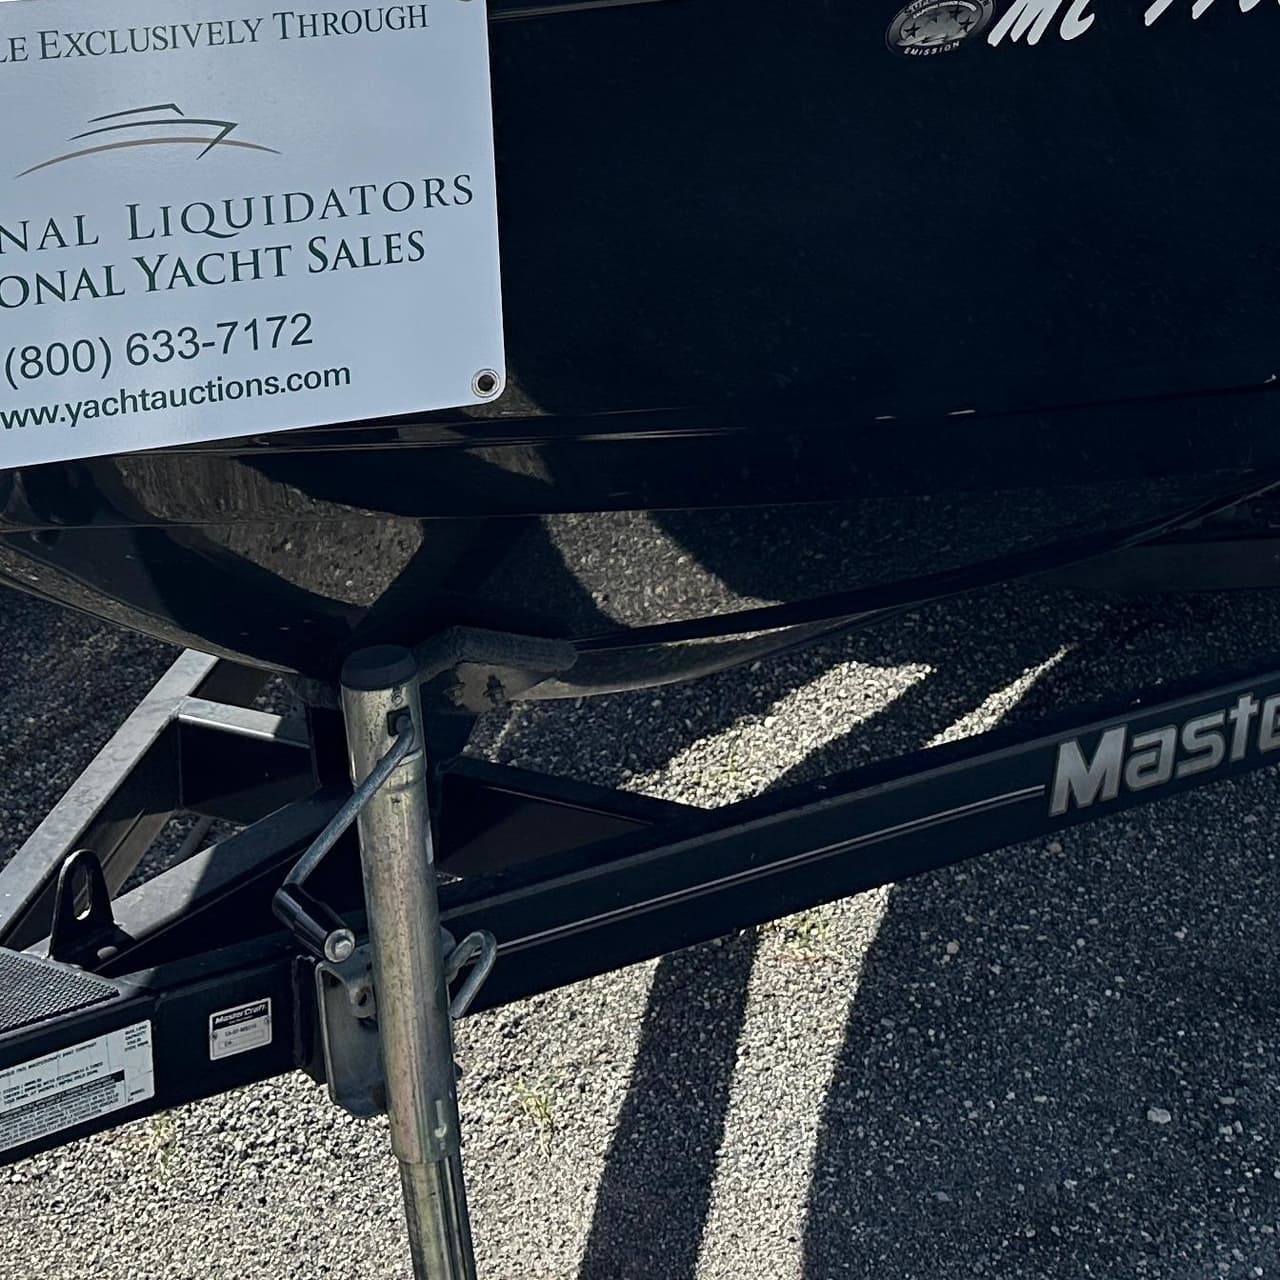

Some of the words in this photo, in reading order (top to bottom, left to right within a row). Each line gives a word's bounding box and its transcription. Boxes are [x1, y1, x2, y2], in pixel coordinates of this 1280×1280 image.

[38, 18, 263, 60] EXCLUSIVELY
[272, 4, 429, 40] THROUGH
[904, 41, 960, 56] EMISSION
[127, 174, 474, 241] LIQUIDATORS
[134, 243, 291, 293] YACHT
[307, 229, 425, 273] SALES
[4, 334, 111, 389] (800)
[126, 312, 313, 366] 633-7172
